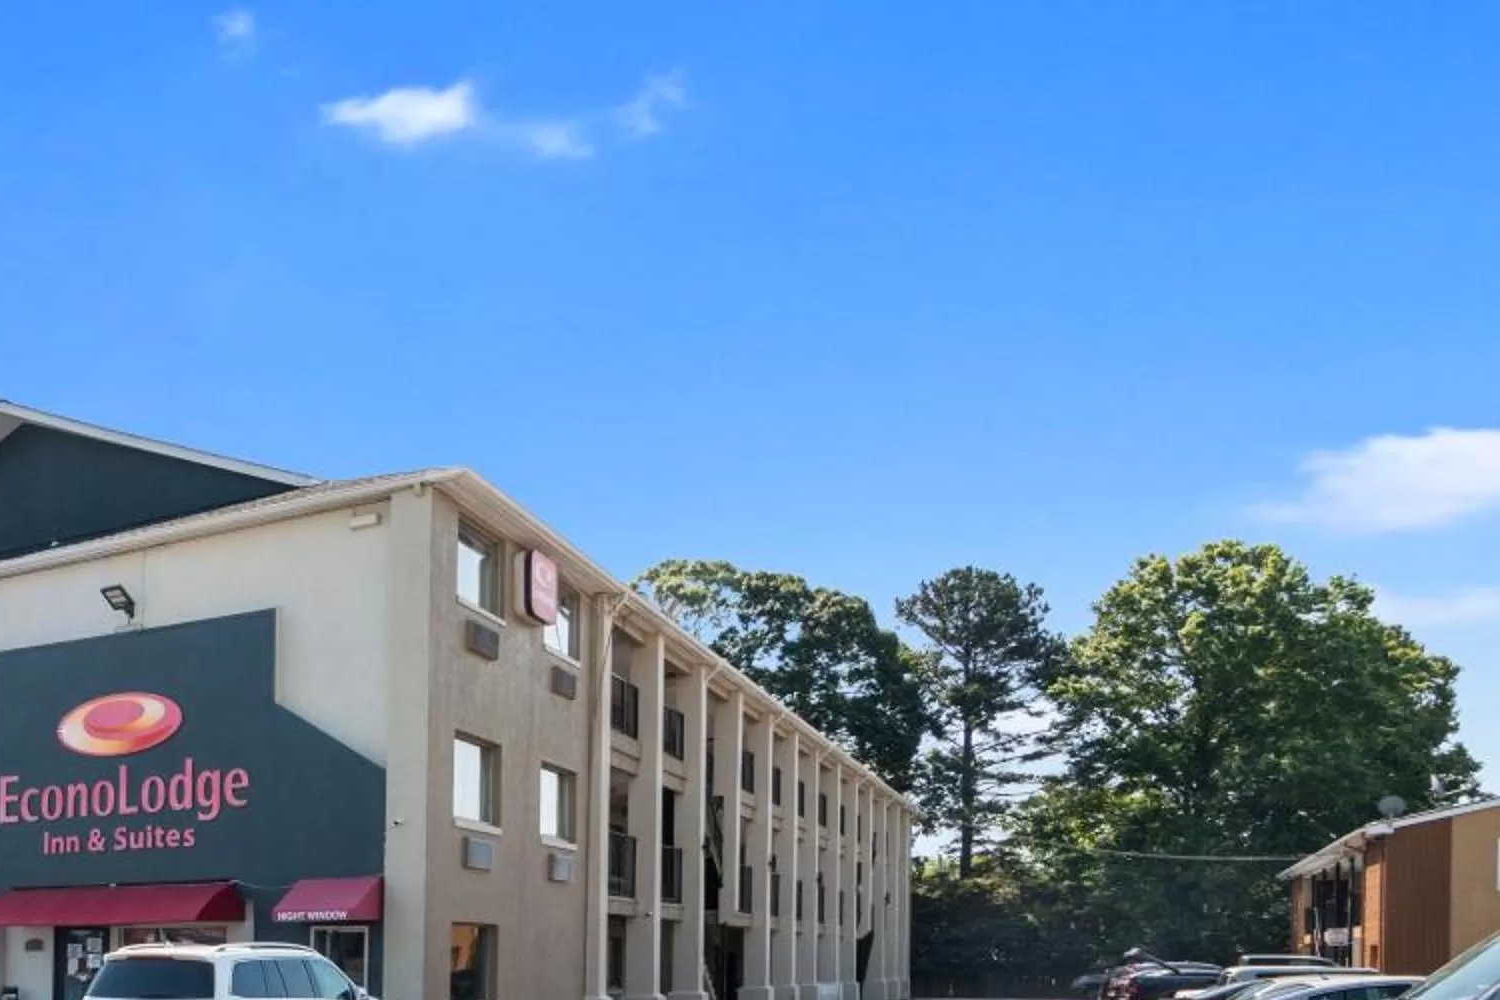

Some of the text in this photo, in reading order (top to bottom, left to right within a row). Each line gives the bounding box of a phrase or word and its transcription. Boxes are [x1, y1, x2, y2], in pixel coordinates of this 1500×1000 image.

[43, 824, 196, 855] Inn & Suites
[307, 910, 348, 921] WINDOW
